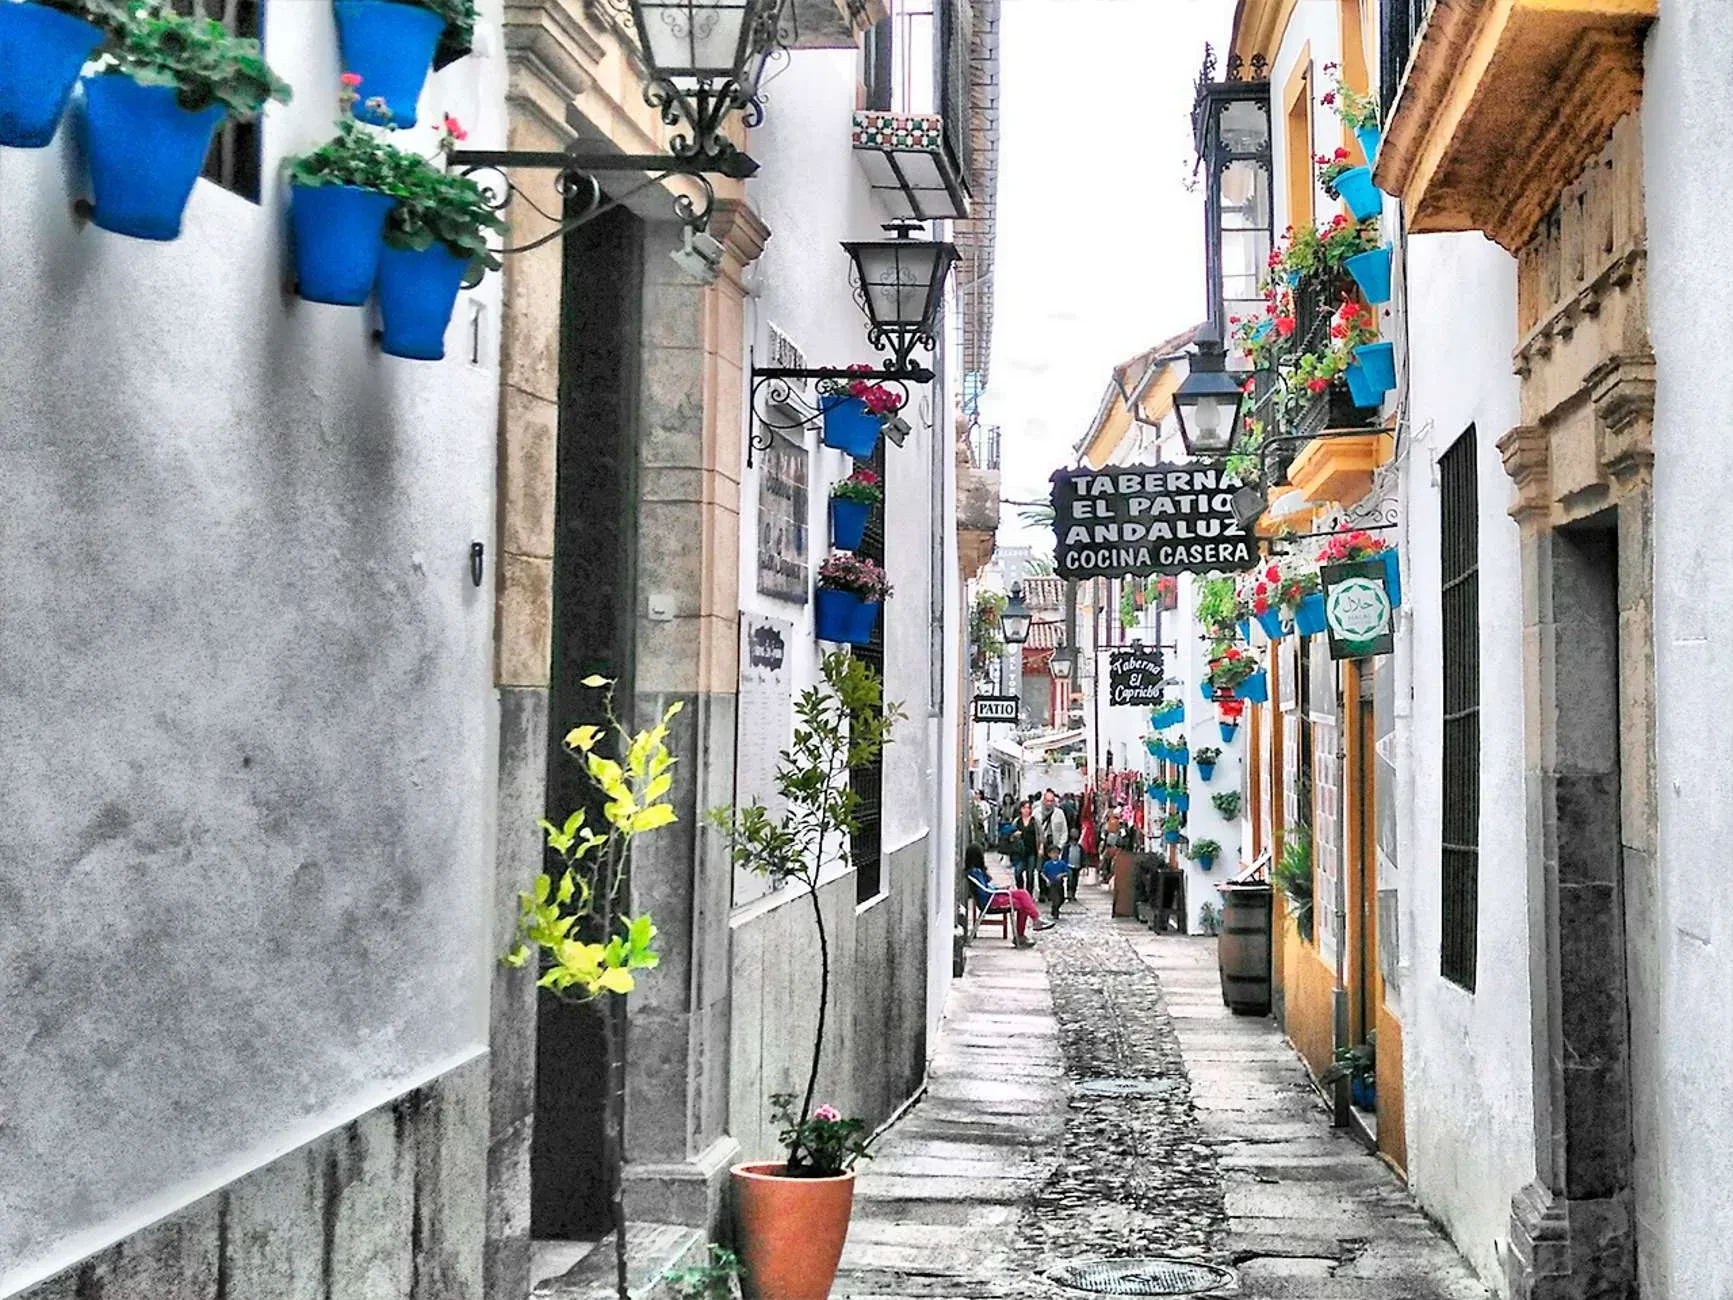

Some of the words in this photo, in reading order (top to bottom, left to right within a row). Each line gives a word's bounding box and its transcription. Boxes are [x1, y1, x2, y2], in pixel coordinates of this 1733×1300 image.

[1071, 469, 1244, 496] TABERNA
[1072, 499, 1115, 520] EL
[1128, 493, 1234, 517] PATIO
[1065, 518, 1246, 546] ANDALUZ
[1065, 546, 1151, 570] COCINA
[1159, 542, 1250, 566] CASERA
[1112, 656, 1161, 675] Taberna
[1129, 673, 1143, 687] El
[980, 703, 1014, 716] PATIO
